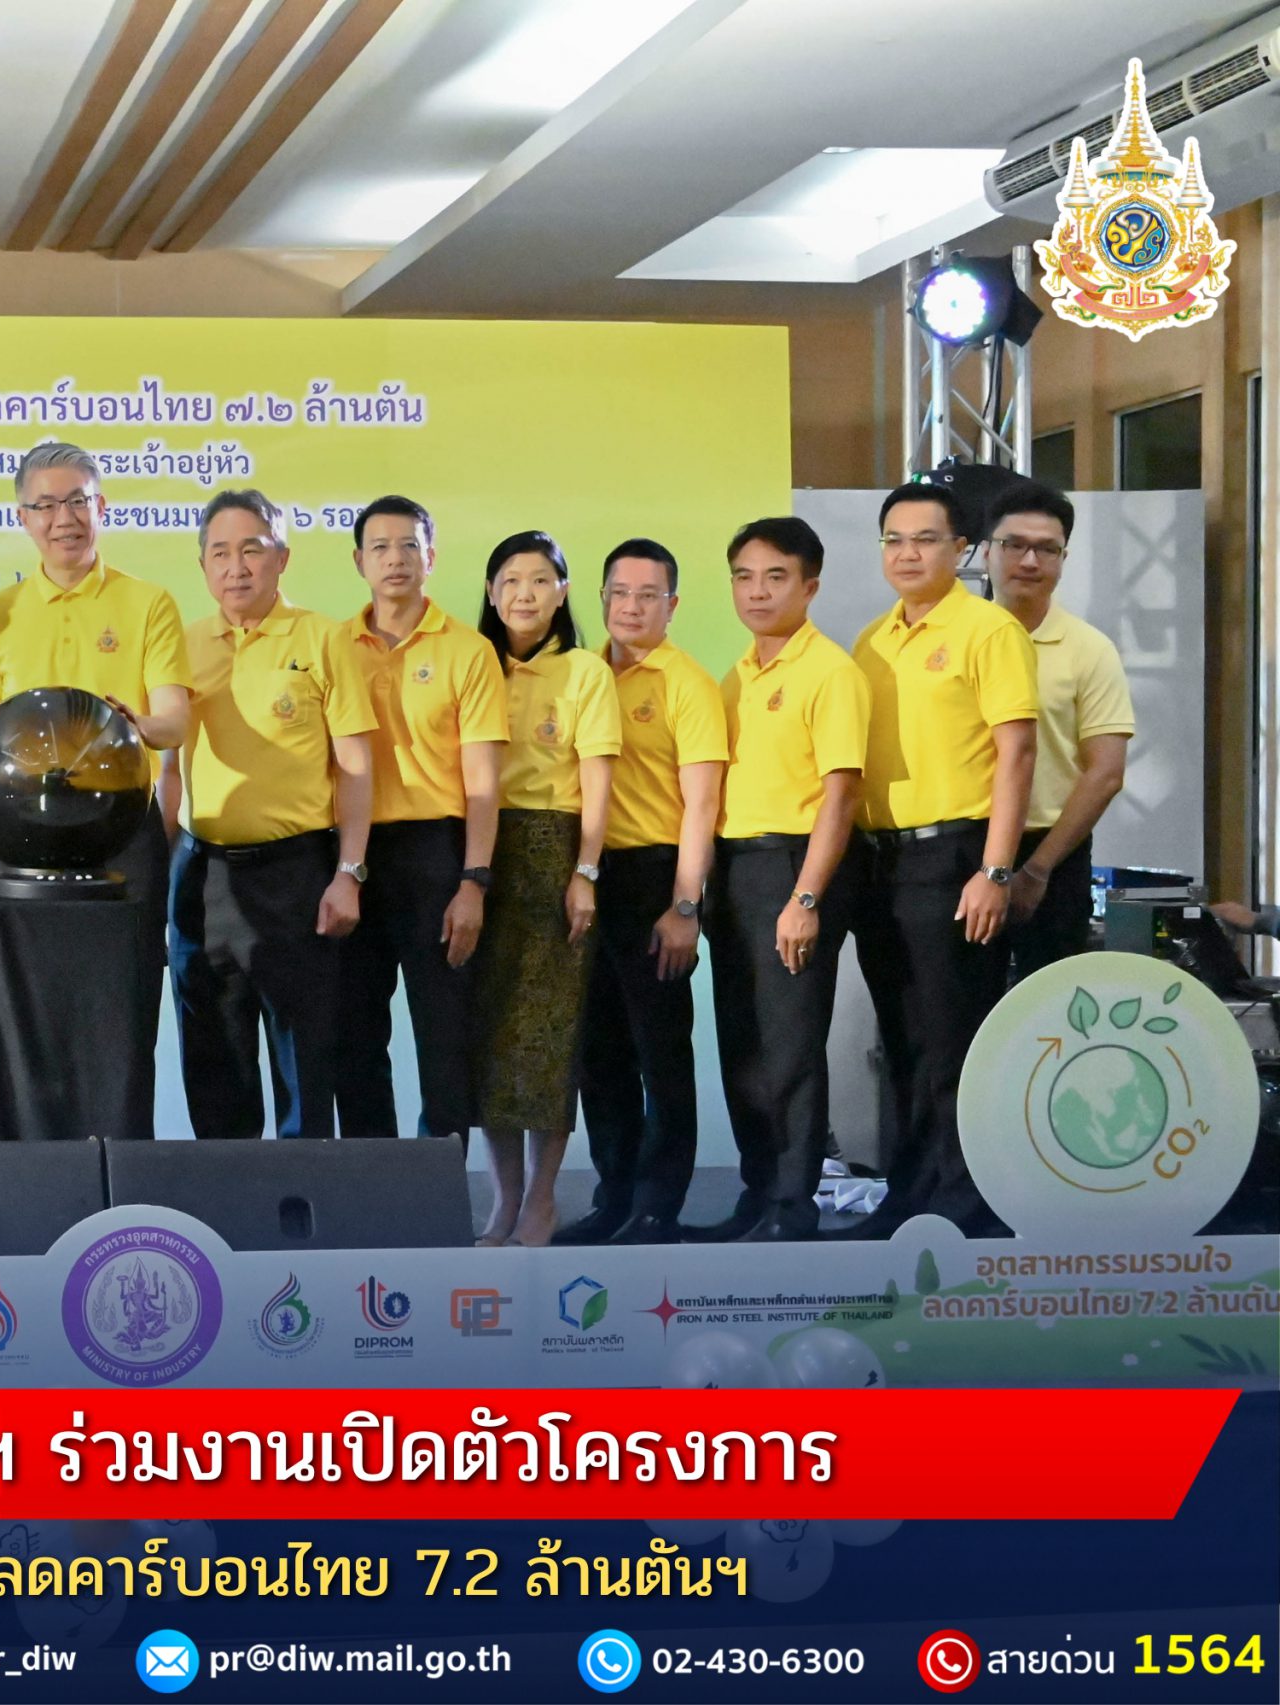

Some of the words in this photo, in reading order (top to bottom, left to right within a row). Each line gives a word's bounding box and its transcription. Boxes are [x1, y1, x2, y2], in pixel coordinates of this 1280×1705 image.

[225, 396, 293, 422] ๗.๒
[305, 383, 422, 422] ล้านตัน
[294, 507, 312, 528] ๖
[322, 507, 364, 528] รอ
[83, 1231, 201, 1268] กระทรวงอุตสาหกรรม
[976, 1244, 1232, 1286] อุตสาหกรรมรวมใจ
[676, 1314, 702, 1324] IRON
[706, 1314, 729, 1323] AND
[732, 1313, 763, 1322] STEEL
[767, 1312, 819, 1322] INSTITUTE
[822, 1311, 837, 1321] OF
[841, 1310, 894, 1320] THAILAND
[922, 1287, 1131, 1320] ลดคาร์บอนไทย
[1139, 1290, 1179, 1315] 7.2
[1185, 1283, 1280, 1315] ล้านตัน
[354, 1336, 414, 1349] DIPROM
[542, 1334, 624, 1346] สถาบันพลาสติก
[82, 1345, 131, 1381] MINISTRY
[134, 1370, 149, 1381] OF
[152, 1343, 203, 1381] INDUSTRY
